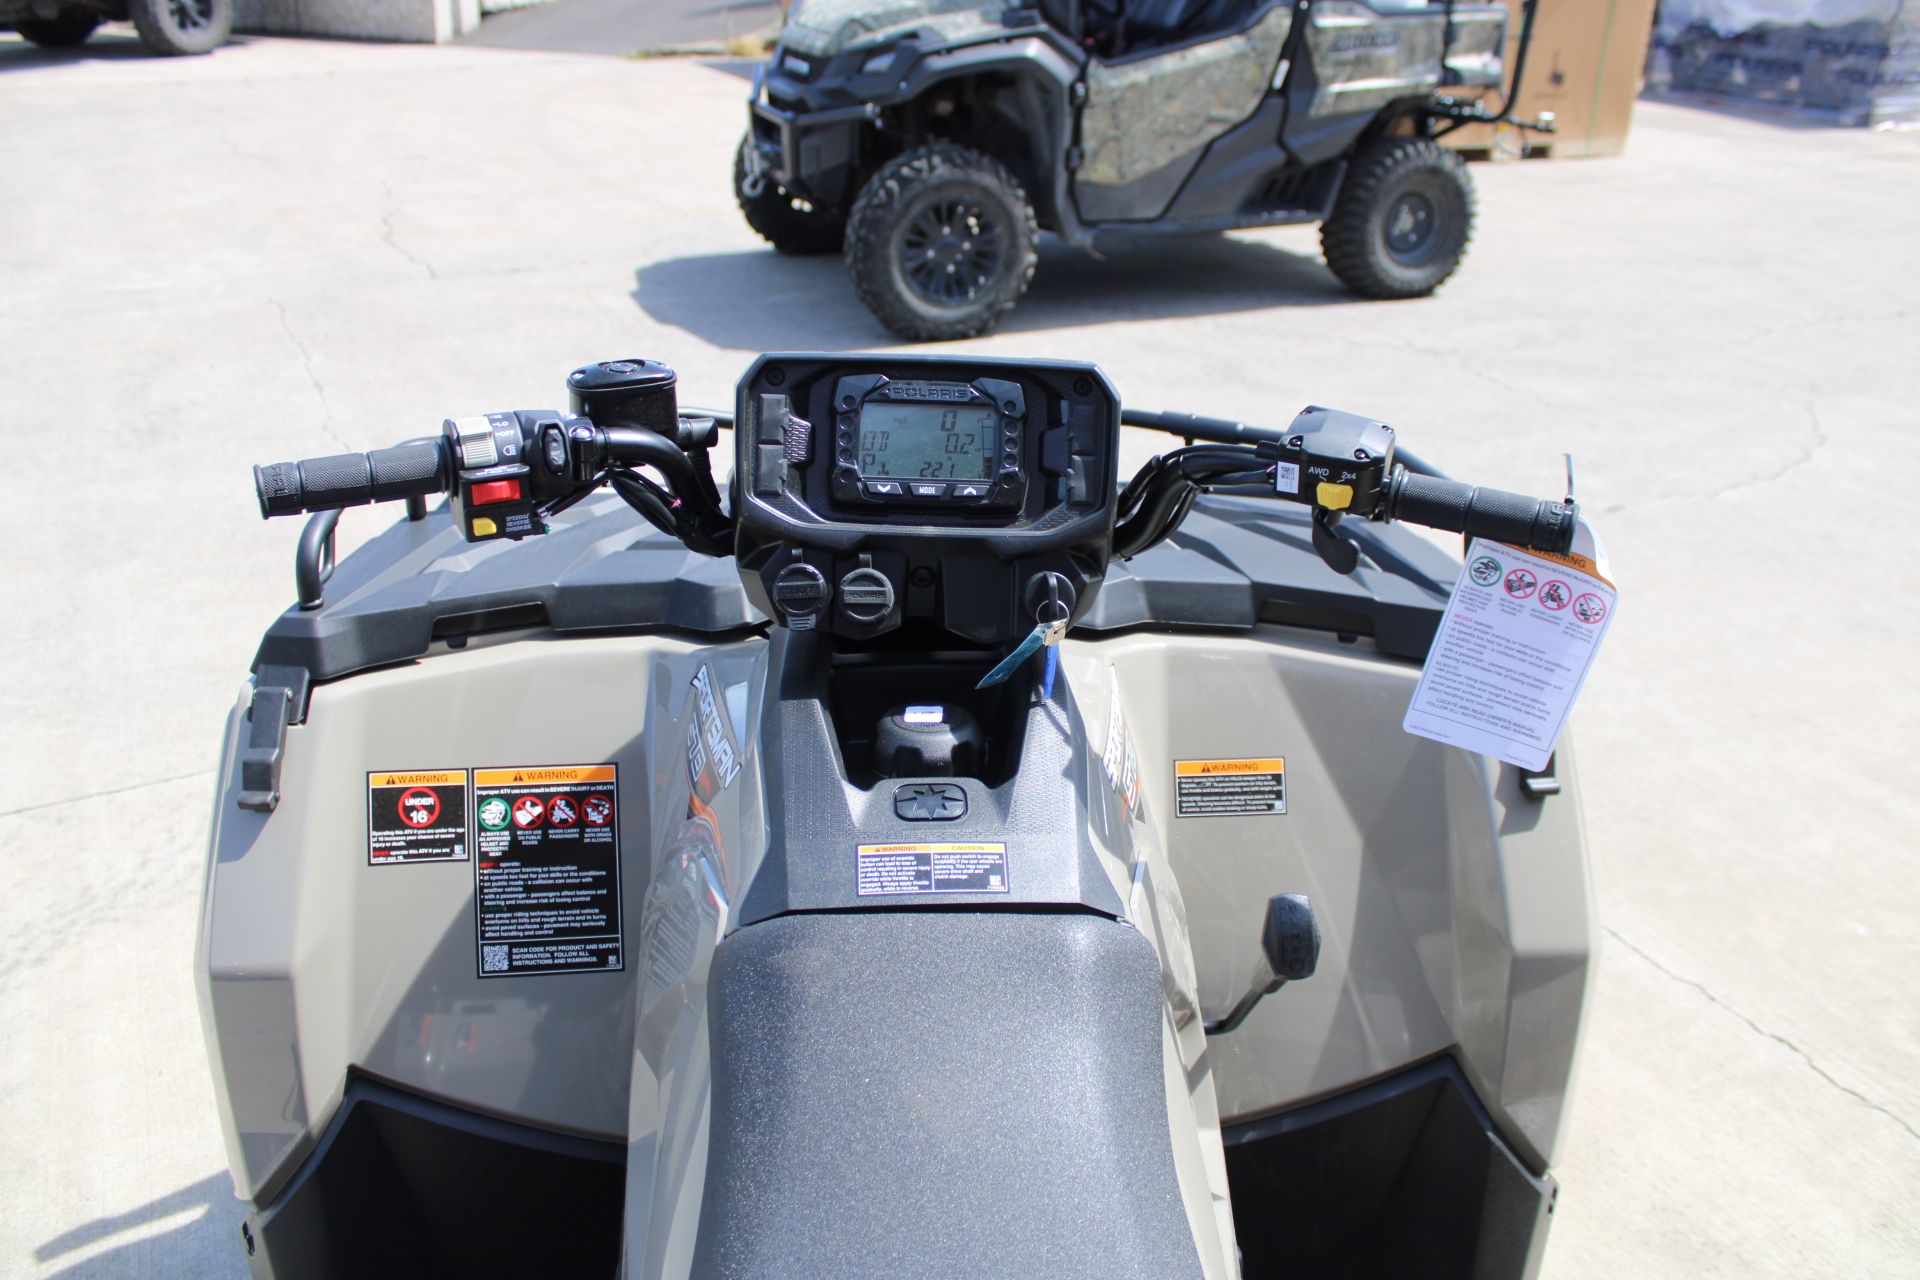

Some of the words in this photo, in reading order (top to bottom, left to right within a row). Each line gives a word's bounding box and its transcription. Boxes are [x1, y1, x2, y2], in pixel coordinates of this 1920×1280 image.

[892, 387, 967, 398] POLARIS
[1308, 466, 1329, 476] AWD
[1341, 471, 1356, 480] 2x4
[919, 486, 936, 495] MODE
[506, 524, 532, 532] OVERRIDE
[1211, 763, 1259, 771] WARNING
[398, 774, 448, 784] WARNING
[527, 770, 578, 780] WARNING
[405, 798, 434, 806] UNDER
[410, 810, 428, 823] 16
